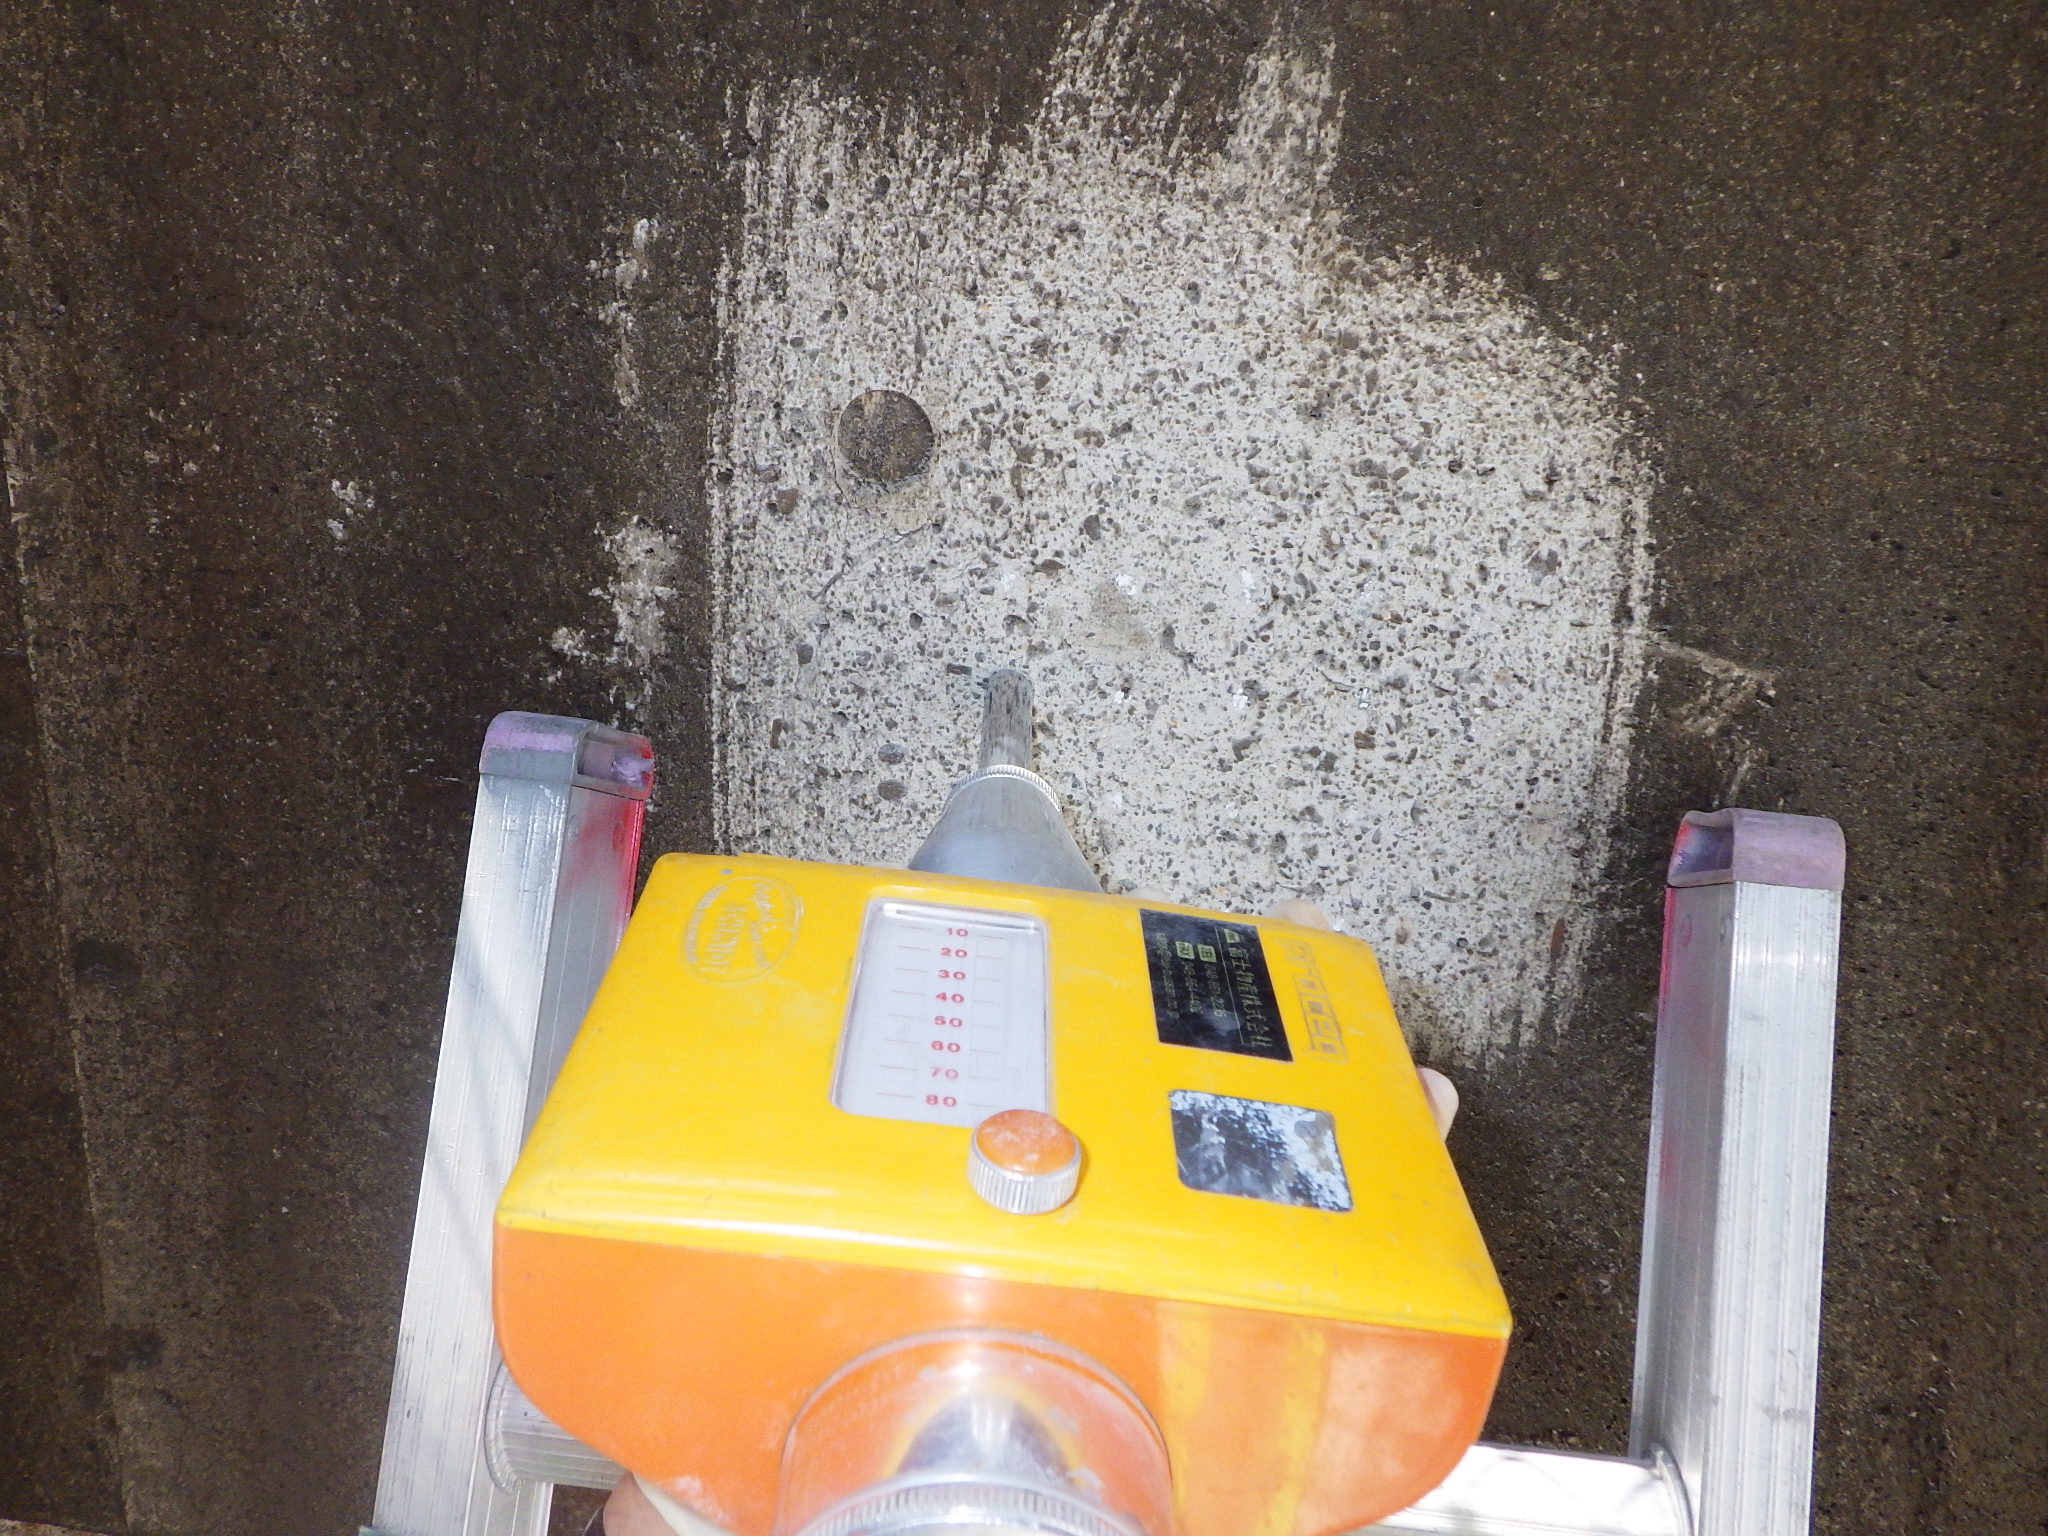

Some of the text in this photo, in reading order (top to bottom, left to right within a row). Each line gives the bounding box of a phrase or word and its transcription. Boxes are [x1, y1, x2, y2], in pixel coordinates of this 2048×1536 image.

[946, 927, 969, 938] 10
[940, 947, 968, 959] 20
[938, 969, 966, 981] 30
[935, 992, 965, 1004] 40
[1228, 946, 1274, 1048] 富士物産株式会社
[934, 1015, 963, 1028] 50
[930, 1040, 961, 1053] 60
[930, 1066, 959, 1080] 70
[925, 1094, 957, 1108] 80
